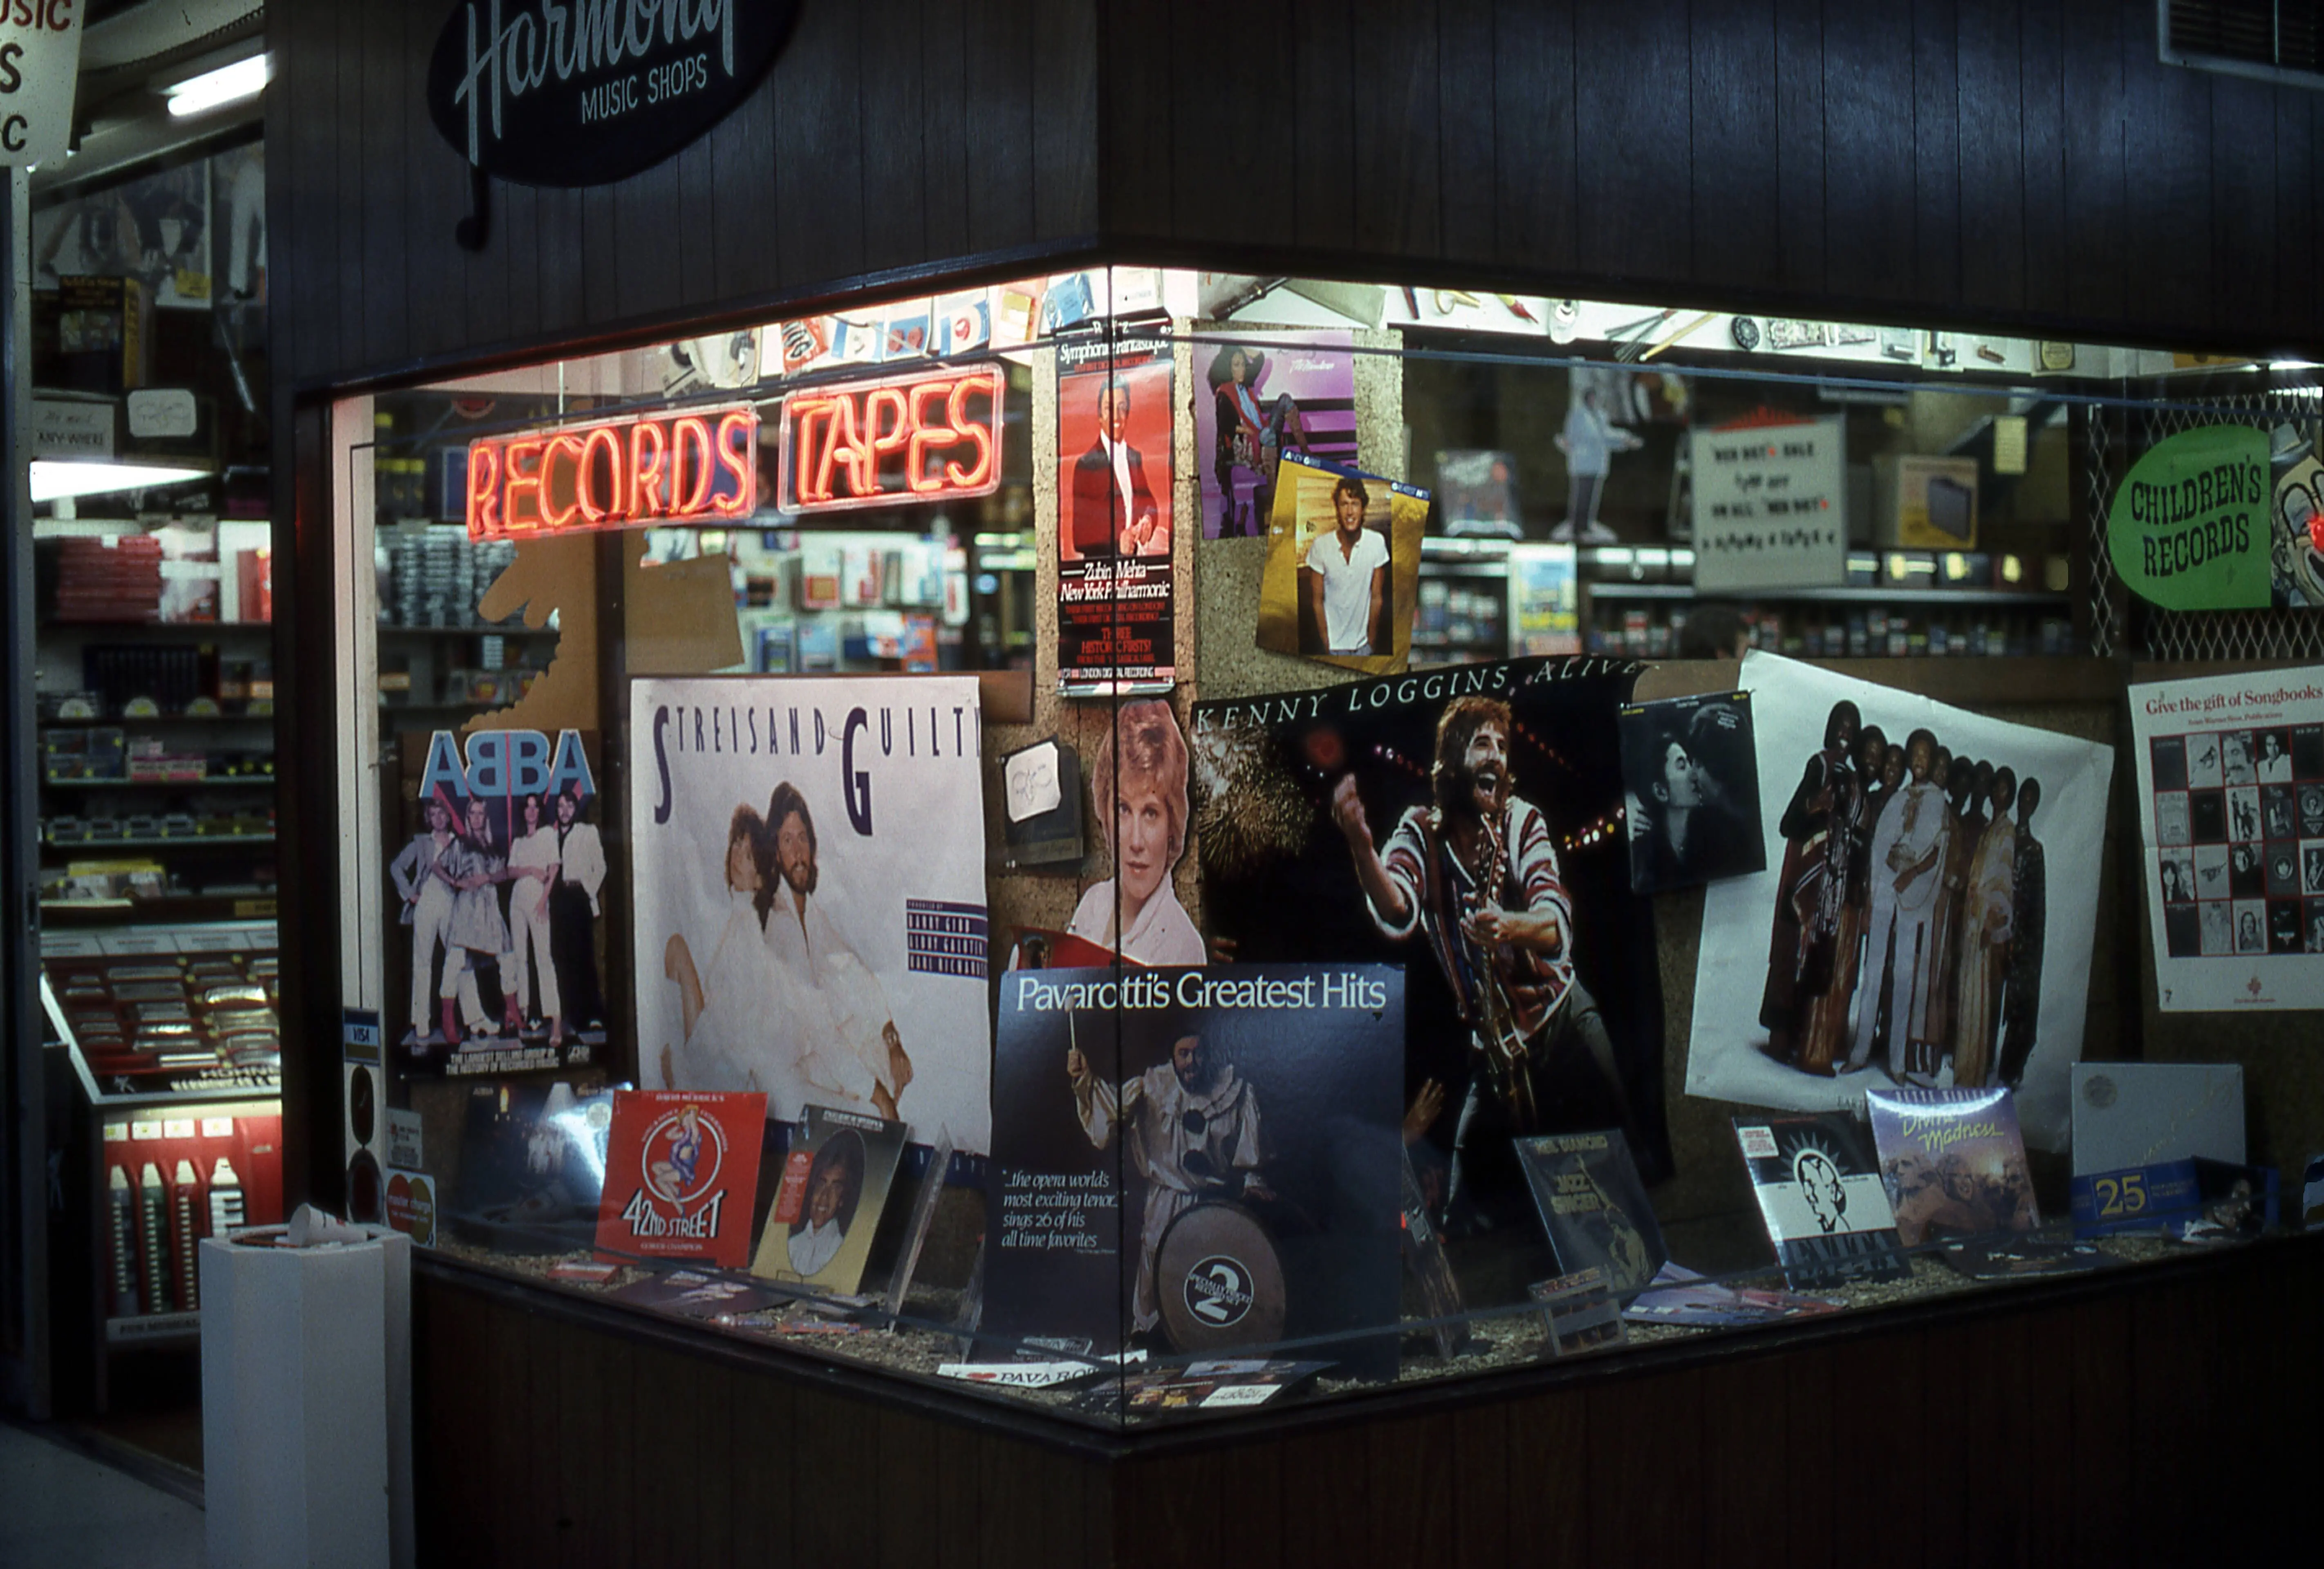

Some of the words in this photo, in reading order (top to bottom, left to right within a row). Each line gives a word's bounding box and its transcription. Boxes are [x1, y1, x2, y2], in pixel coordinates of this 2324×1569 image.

[455, 0, 735, 167] Harmony
[581, 75, 639, 124] MUSIC
[648, 52, 708, 104] SHOPS
[1060, 340, 1115, 364] Symphoni
[468, 410, 754, 536] RECORDS
[789, 375, 996, 505] TAPES
[2130, 454, 2261, 525] CHILDREN'S
[2142, 512, 2250, 578] RECORDS
[1084, 561, 1112, 581] Zubin
[1116, 559, 1147, 579] Mehta
[1060, 583, 1084, 602] New
[1084, 581, 1105, 601] York
[1196, 692, 1327, 734] KENNY
[1347, 665, 1510, 711] LOGGINS
[1533, 656, 1639, 684] ALIVE
[2146, 698, 2178, 715] Give
[2180, 696, 2201, 712] the
[2203, 693, 2226, 712] gift
[2228, 691, 2241, 707] of
[2244, 684, 2324, 706] Songbooks
[418, 729, 596, 798] ABBA
[653, 705, 825, 825] STREISAND
[1017, 972, 1170, 1012] Pavarotti's
[1177, 971, 1316, 1009] Greatest
[1321, 972, 1387, 1009] Hits
[353, 1026, 370, 1043] VISA
[1918, 1122, 2005, 1154] Madness
[1003, 1191, 1033, 1207] most
[1035, 1191, 1081, 1211] exciting
[1032, 1174, 1066, 1191] opera
[2095, 1174, 2146, 1215] 25
[621, 1188, 667, 1236] 42ND
[666, 1189, 726, 1238] STREET
[1003, 1210, 1033, 1230] sings
[1035, 1212, 1052, 1228] 26
[1054, 1209, 1068, 1231] of
[1067, 1211, 1086, 1227] his
[1001, 1230, 1017, 1247] all
[1019, 1231, 1046, 1247] time
[1047, 1230, 1098, 1250] favorites
[1788, 1231, 1901, 1280] EVITA
[1001, 1365, 1100, 1383] PAVARO
